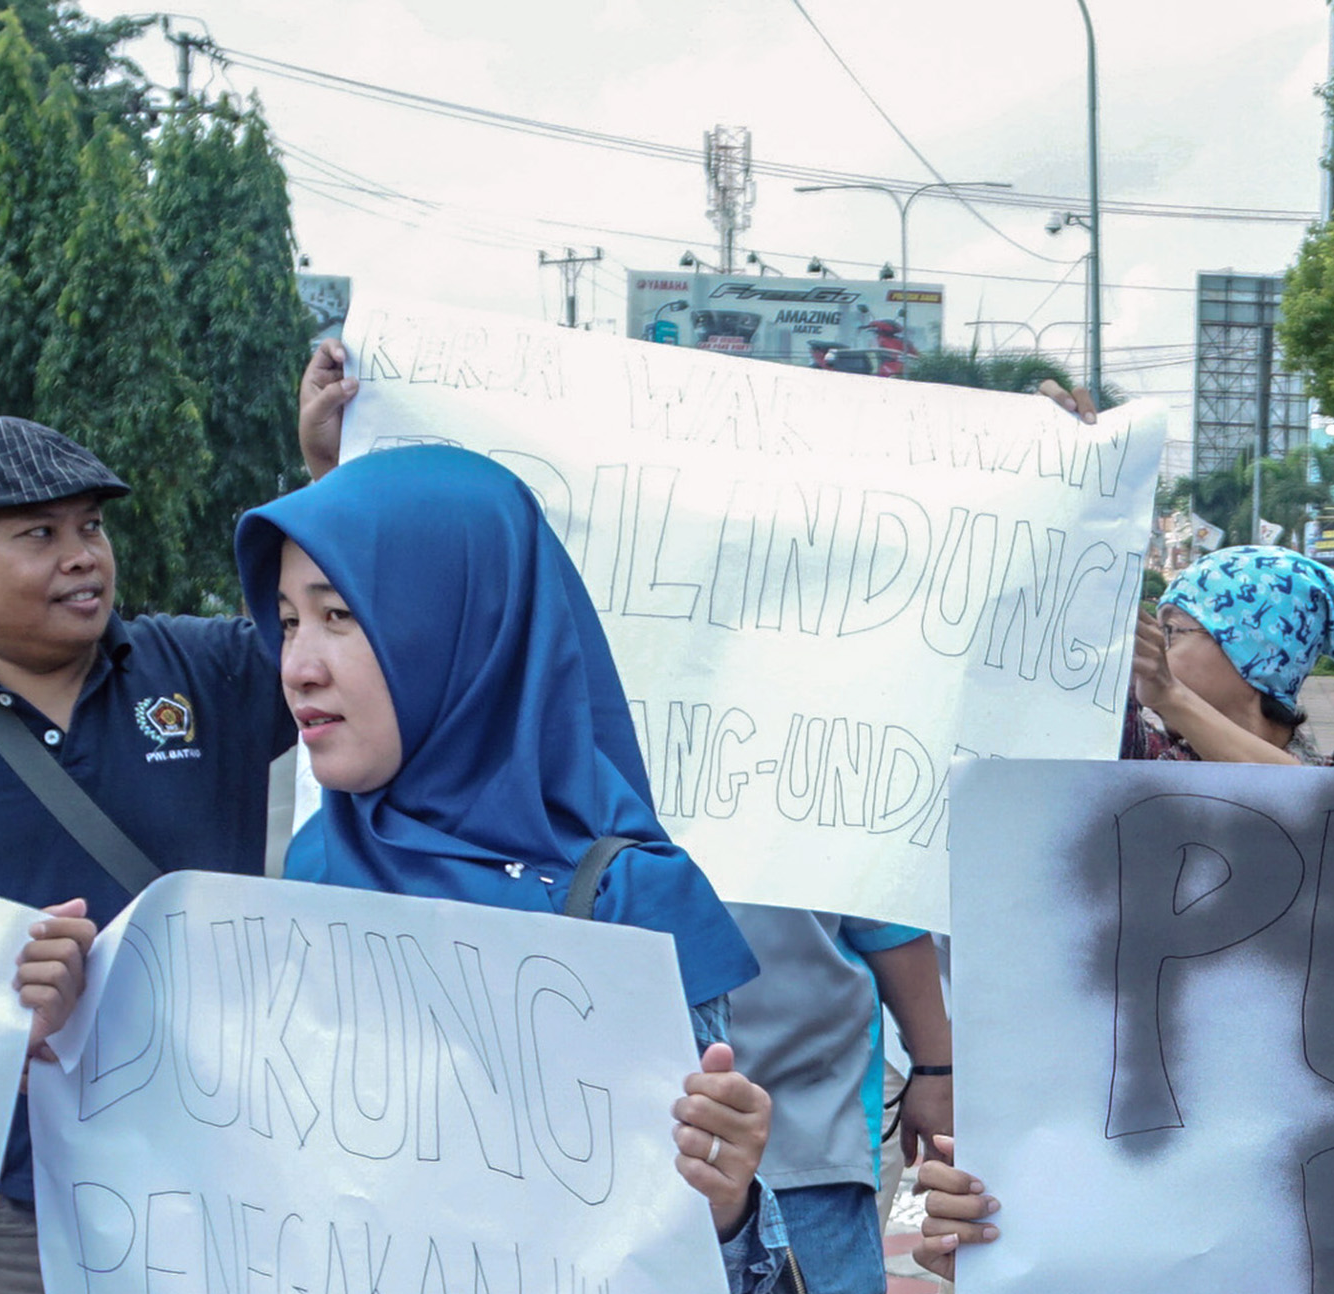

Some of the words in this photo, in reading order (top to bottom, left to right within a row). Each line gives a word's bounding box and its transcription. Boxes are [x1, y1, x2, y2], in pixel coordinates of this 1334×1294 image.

[648, 280, 689, 292] YAMAHA
[775, 309, 842, 325] AMAZING
[793, 325, 823, 335] MATIC
[624, 350, 1133, 498] WARAWAN
[77, 910, 614, 1206] DUKUNG
